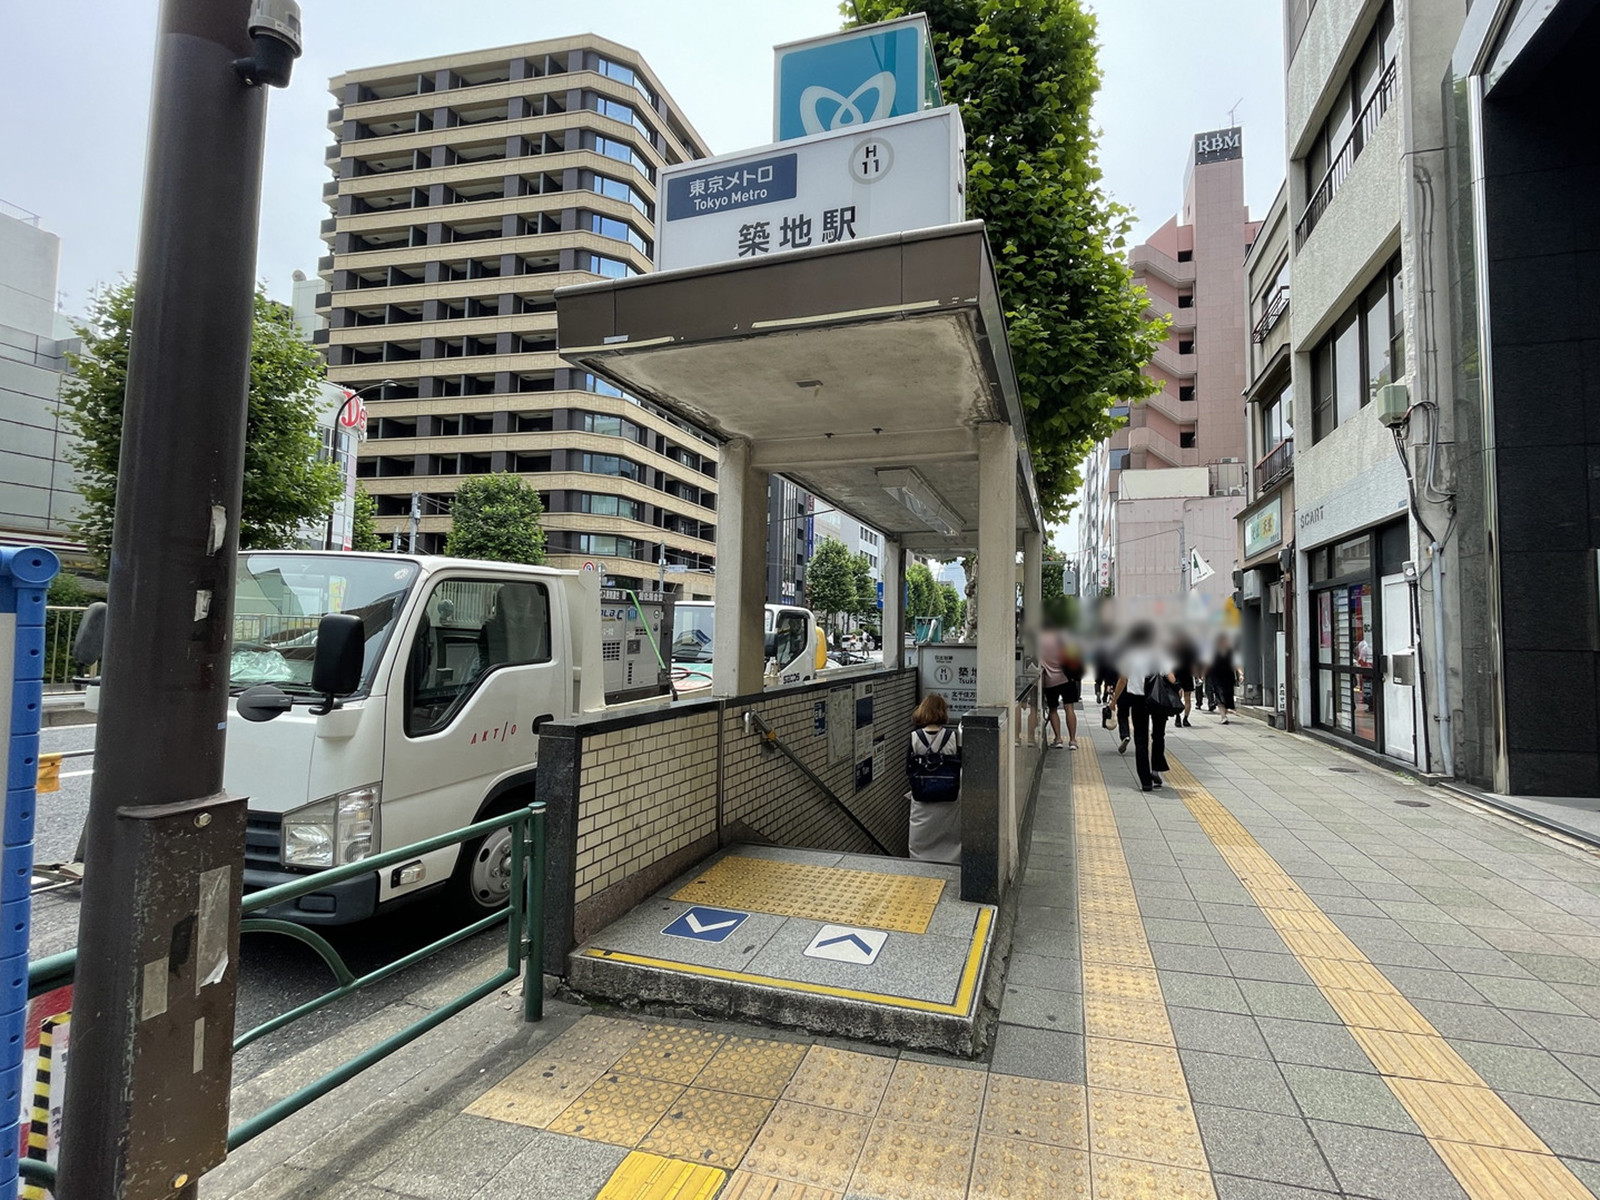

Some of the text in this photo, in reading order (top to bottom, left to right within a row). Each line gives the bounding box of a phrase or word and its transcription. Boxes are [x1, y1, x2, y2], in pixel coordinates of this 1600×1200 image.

[865, 145, 877, 159] H
[1198, 134, 1240, 153] RBM
[861, 159, 880, 175] 11
[689, 165, 773, 198] 東京メトロ
[693, 187, 768, 212] Tokyo Metro
[738, 206, 857, 258] 築地駅
[1300, 504, 1325, 529] SCART
